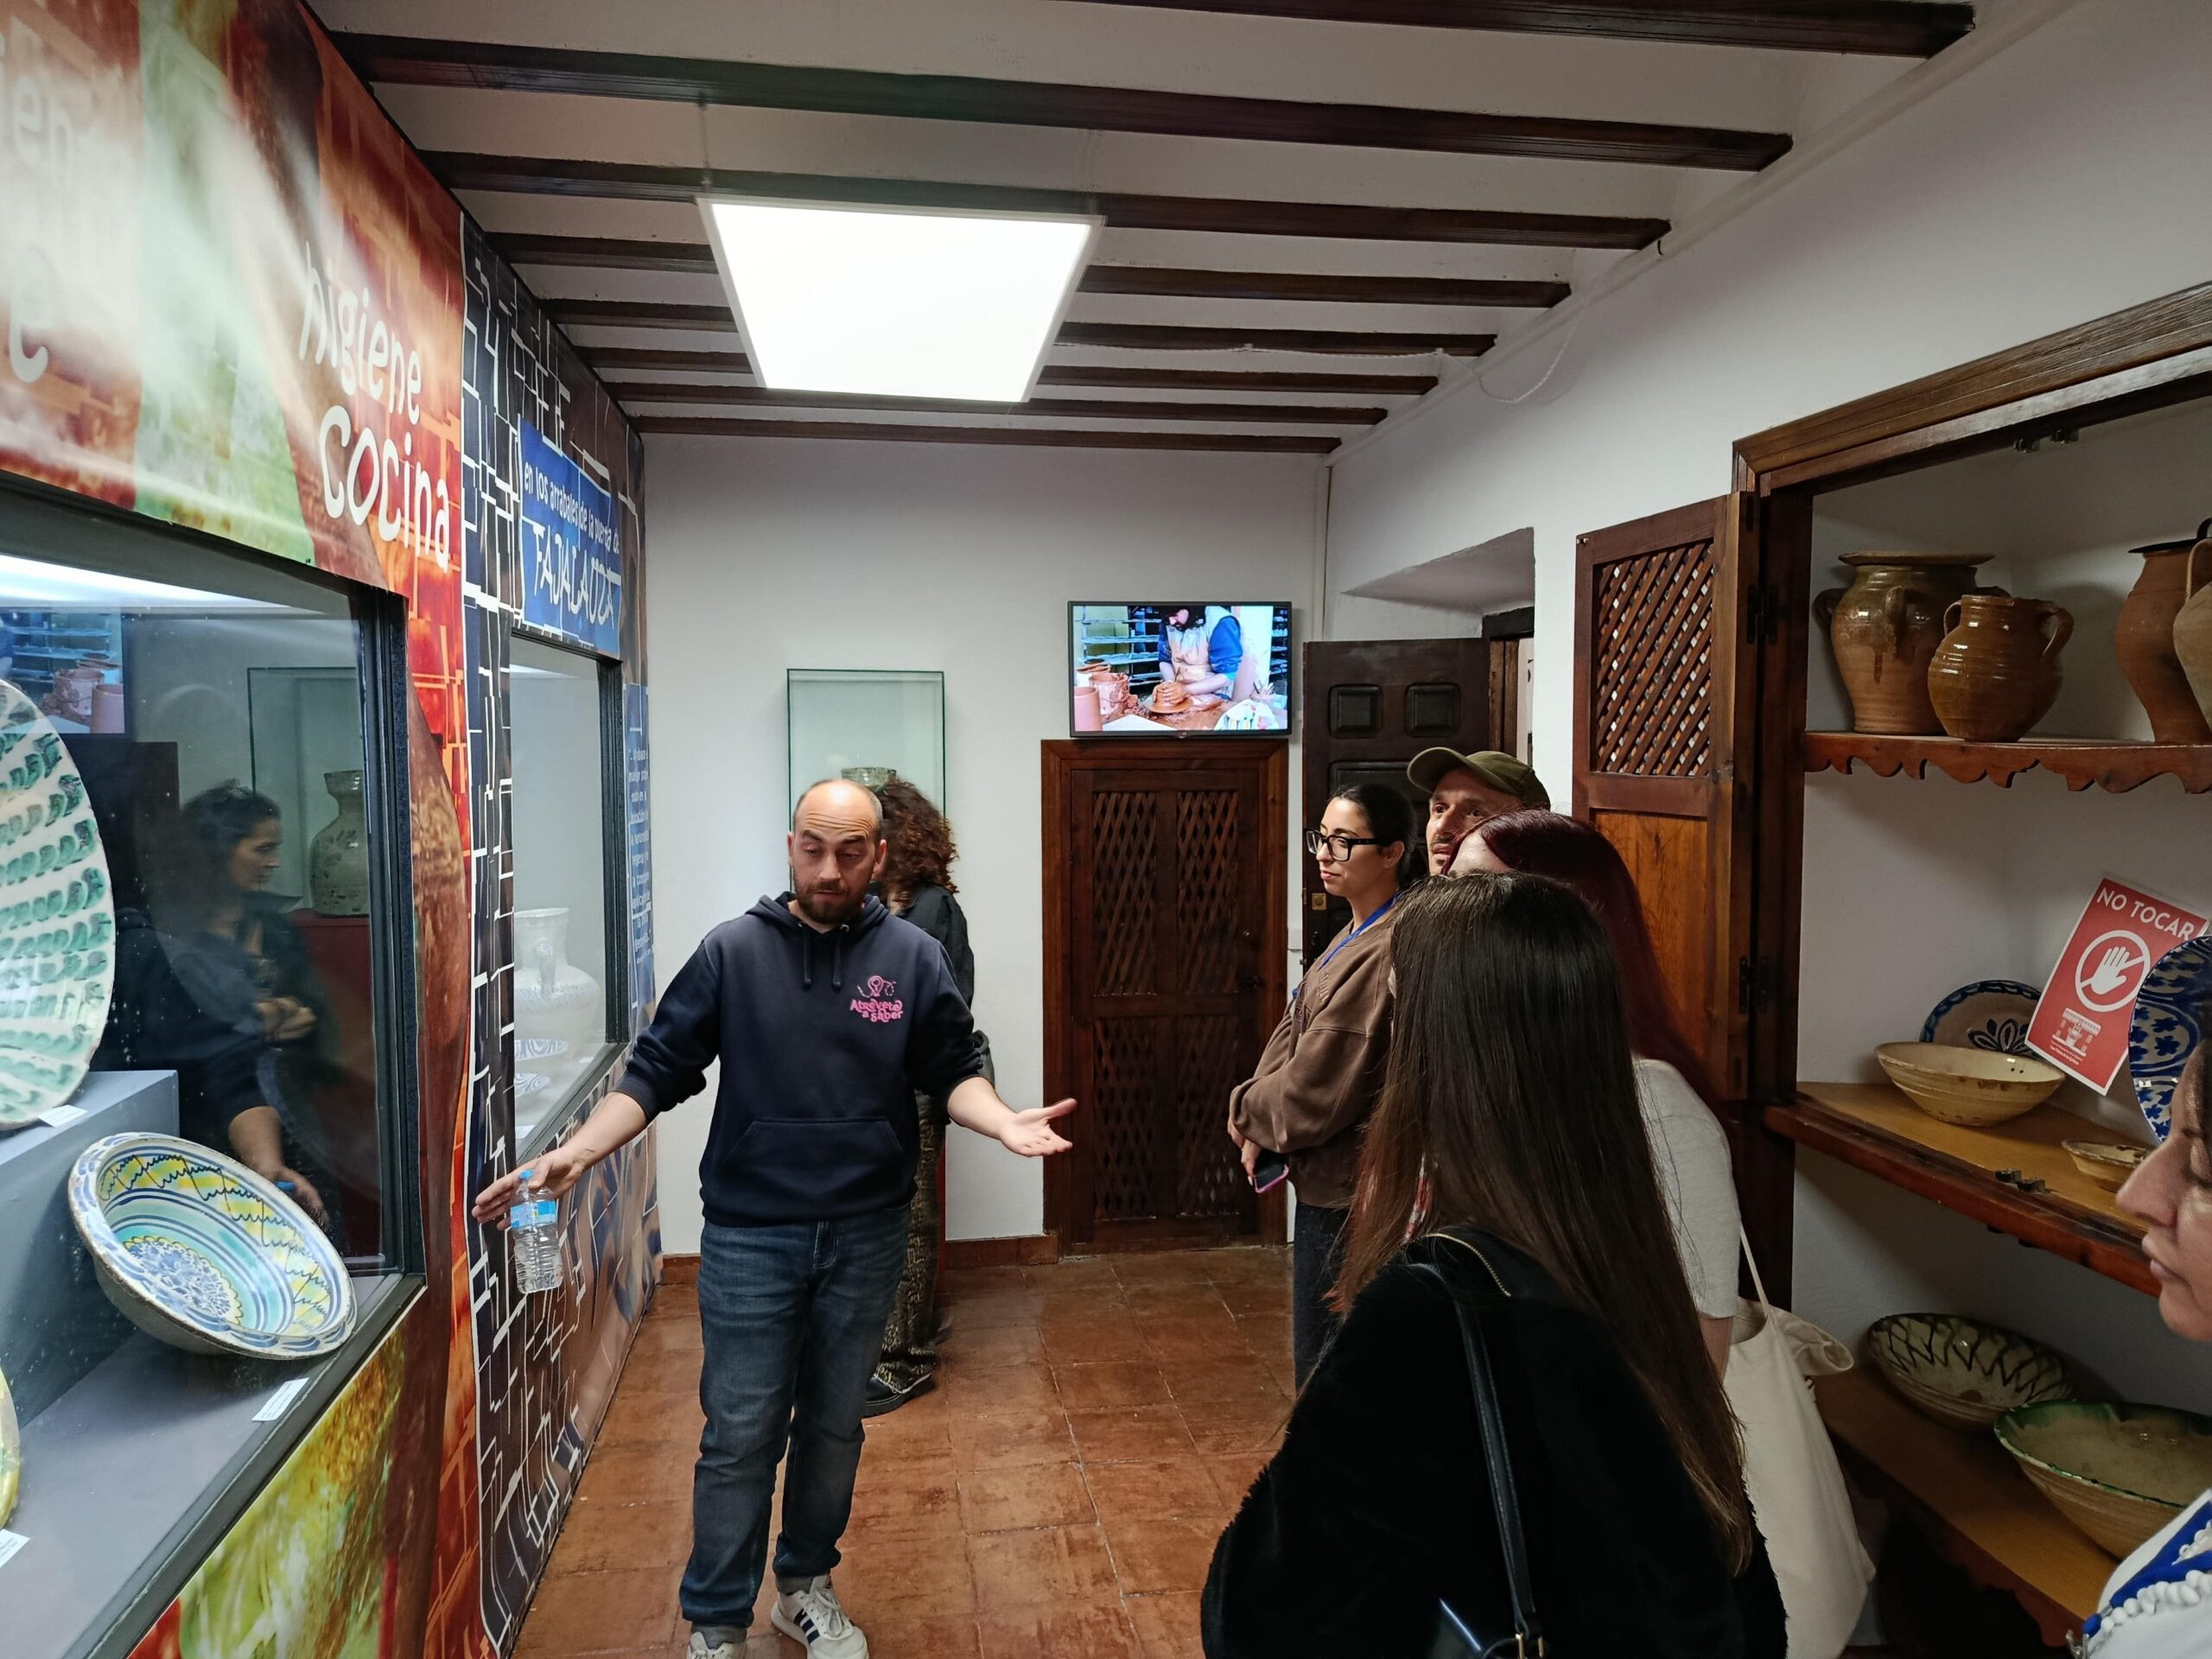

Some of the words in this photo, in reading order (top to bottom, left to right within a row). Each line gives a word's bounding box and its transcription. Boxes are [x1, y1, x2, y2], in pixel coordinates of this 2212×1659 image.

[299, 242, 422, 425] higiene
[524, 461, 533, 495] en
[536, 467, 549, 505] los
[550, 481, 578, 527] arrabales
[579, 500, 588, 532] de
[588, 508, 594, 540] la
[2096, 887, 2127, 911] NO
[2130, 900, 2195, 941] TOCAR
[870, 1007, 904, 1023] saber
